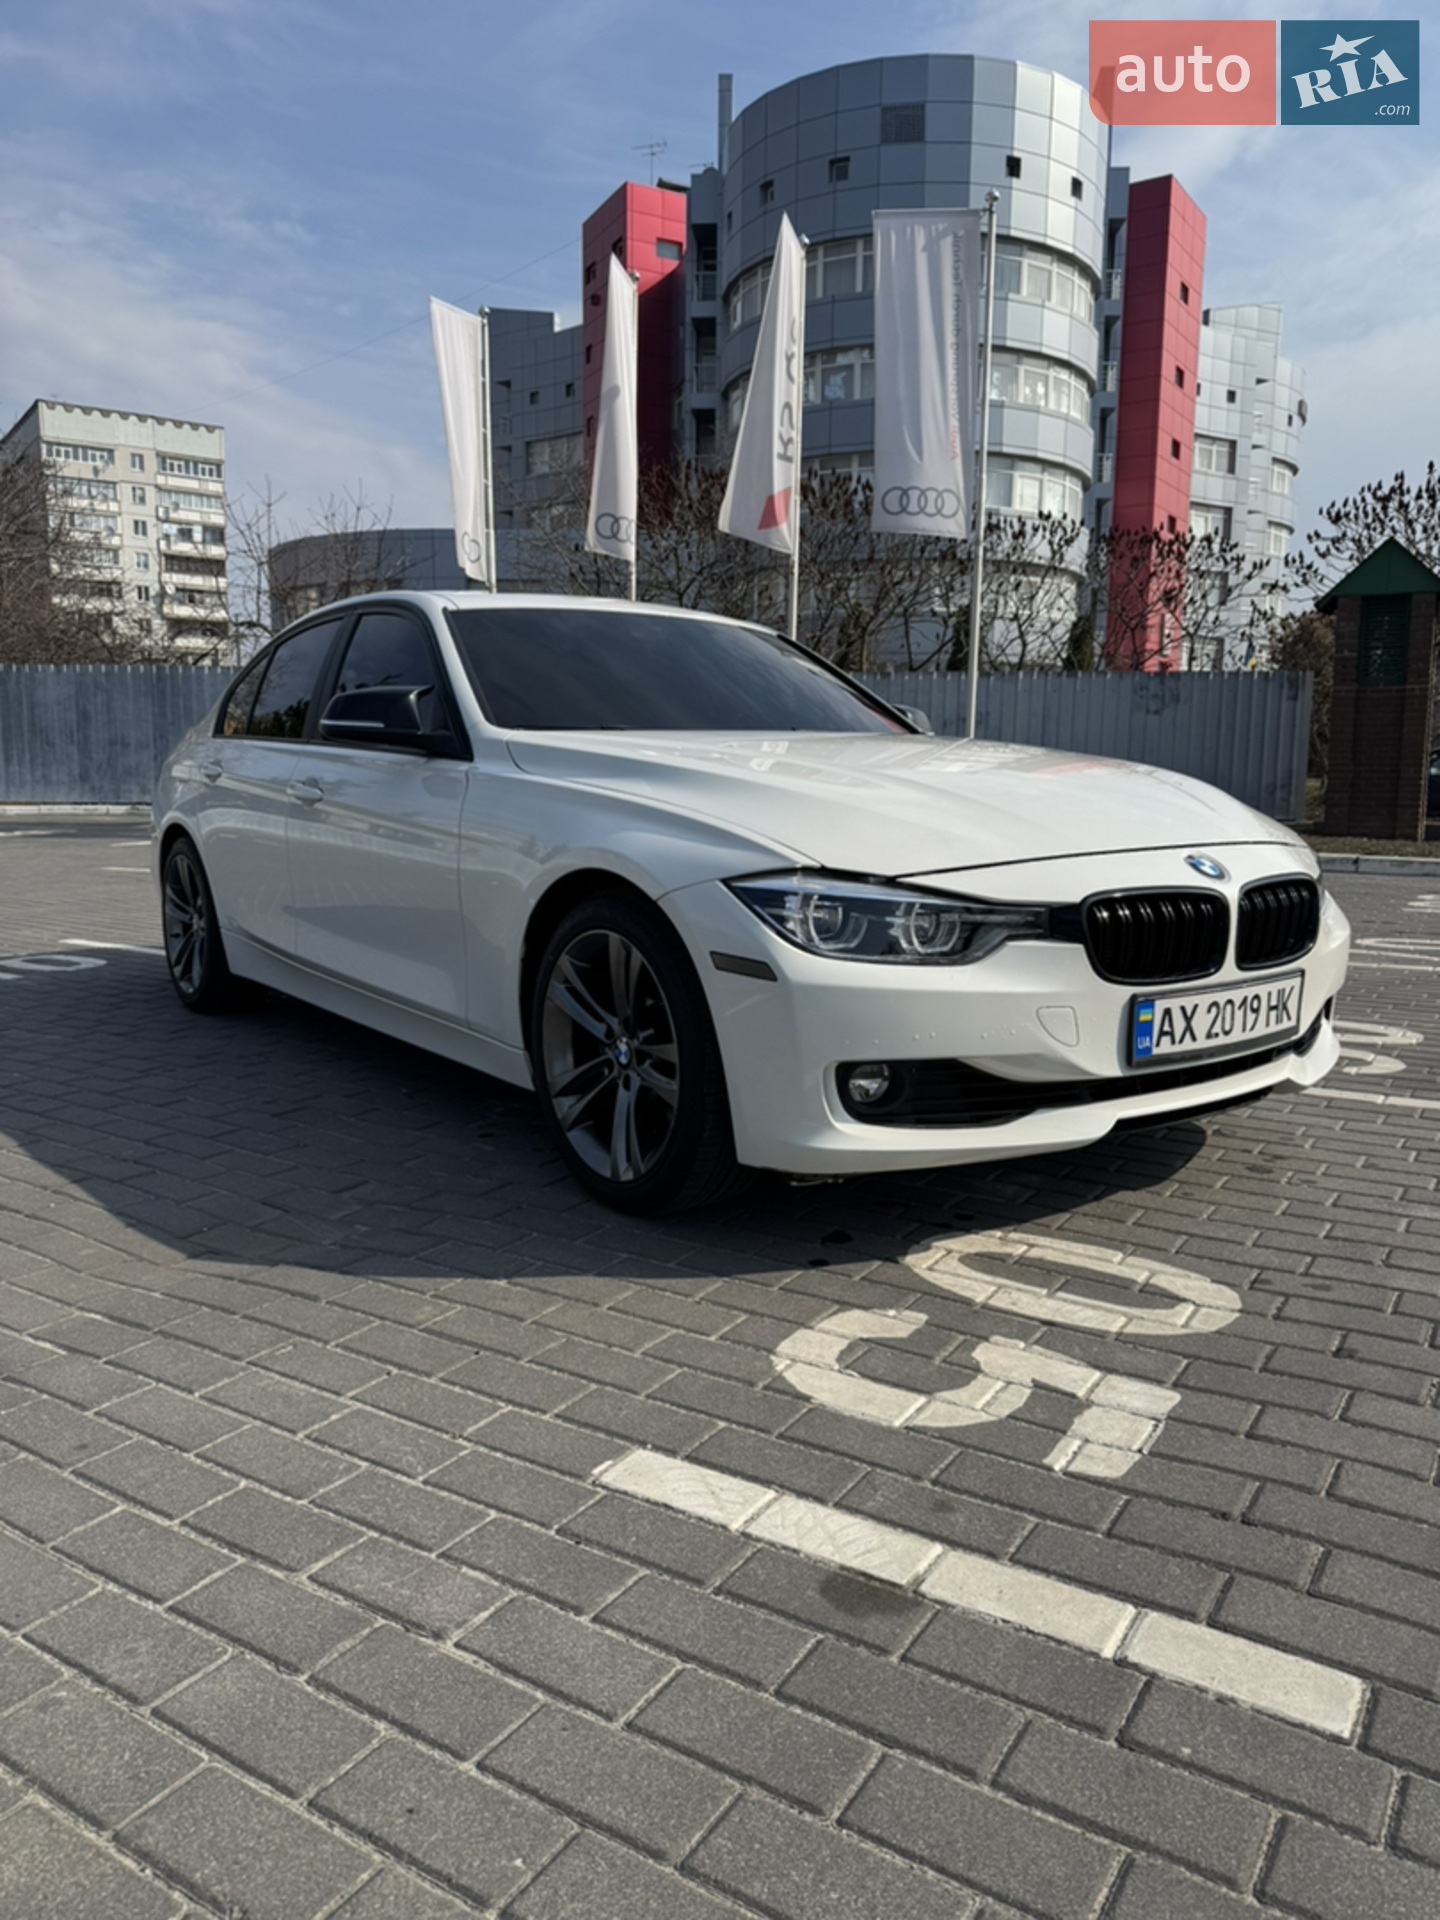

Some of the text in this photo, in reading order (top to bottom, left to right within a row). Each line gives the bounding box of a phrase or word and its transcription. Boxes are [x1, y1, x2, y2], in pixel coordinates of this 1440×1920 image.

[1155, 985, 1296, 1047] AX 2019 HK
[1137, 1036, 1151, 1049] UA
